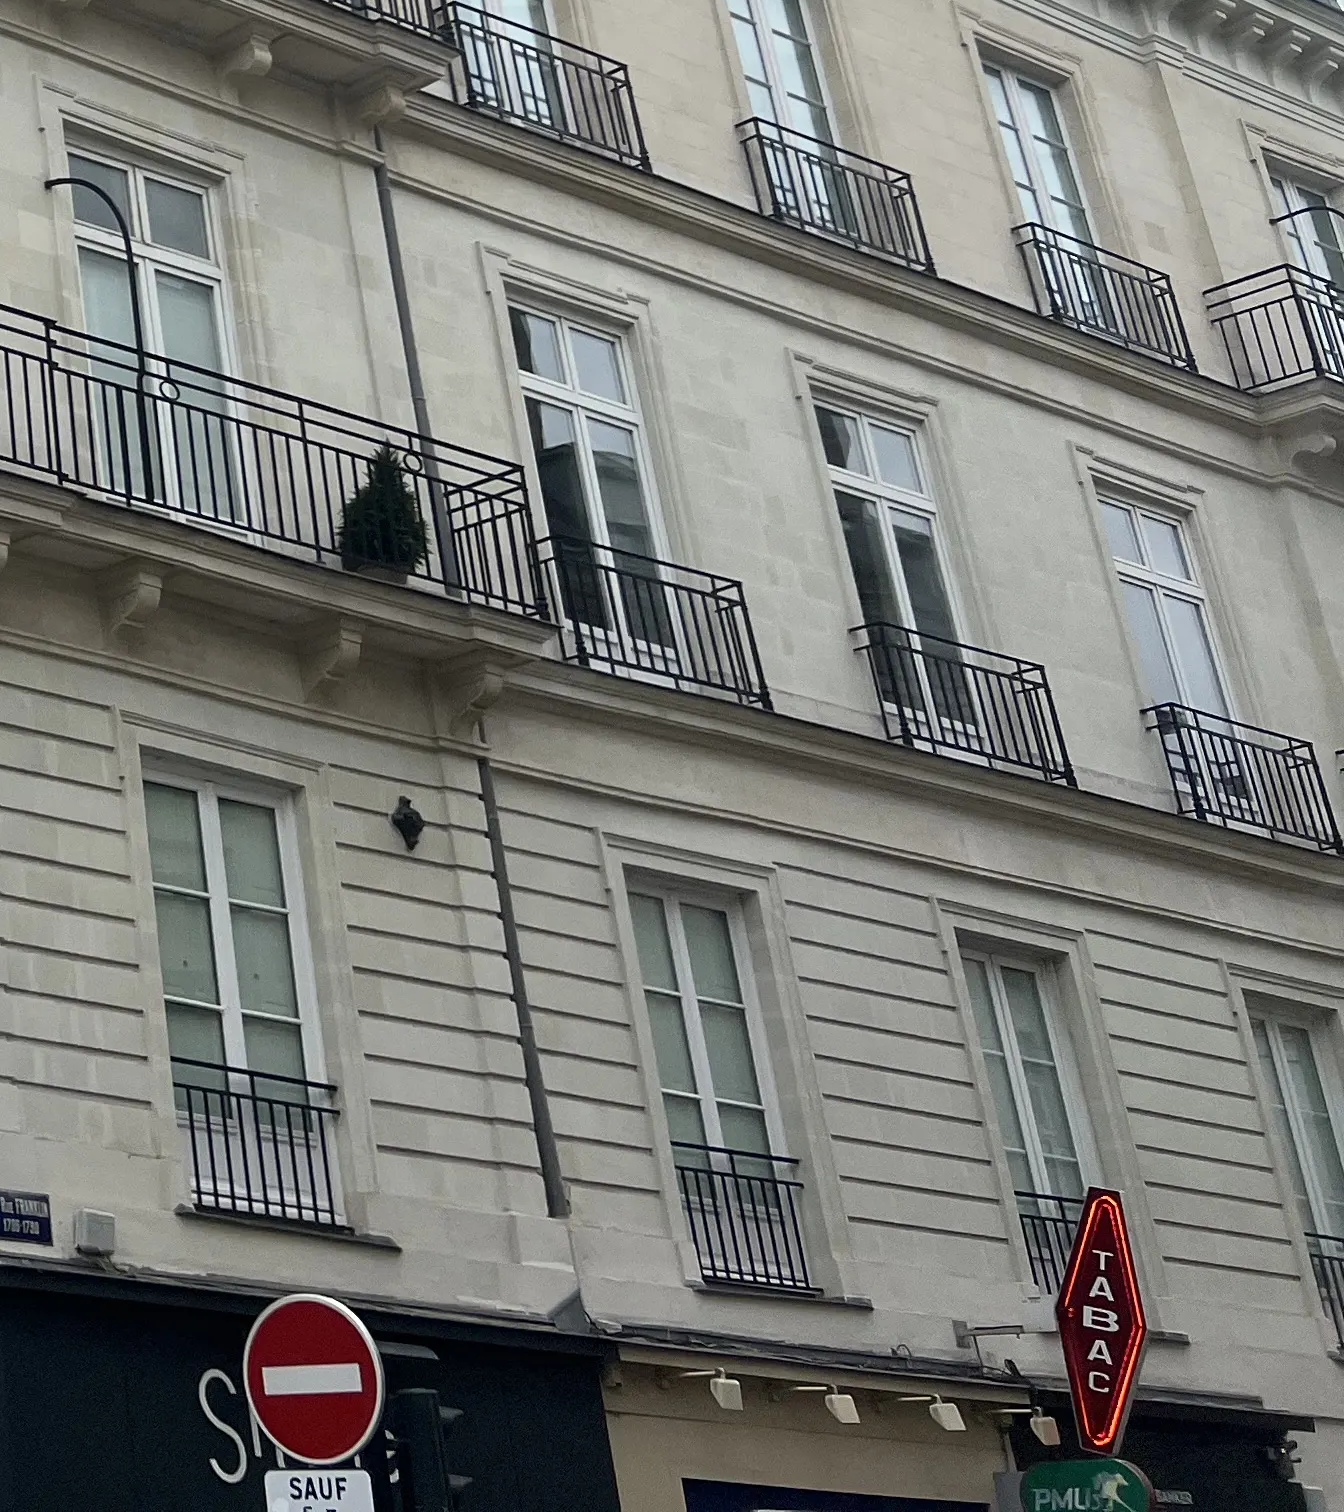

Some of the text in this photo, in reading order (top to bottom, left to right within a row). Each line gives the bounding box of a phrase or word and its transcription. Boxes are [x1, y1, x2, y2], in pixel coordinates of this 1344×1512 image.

[1082, 1249, 1120, 1393] TABAC
[289, 1477, 347, 1500] SAUF
[1033, 1487, 1087, 1511] PMU
